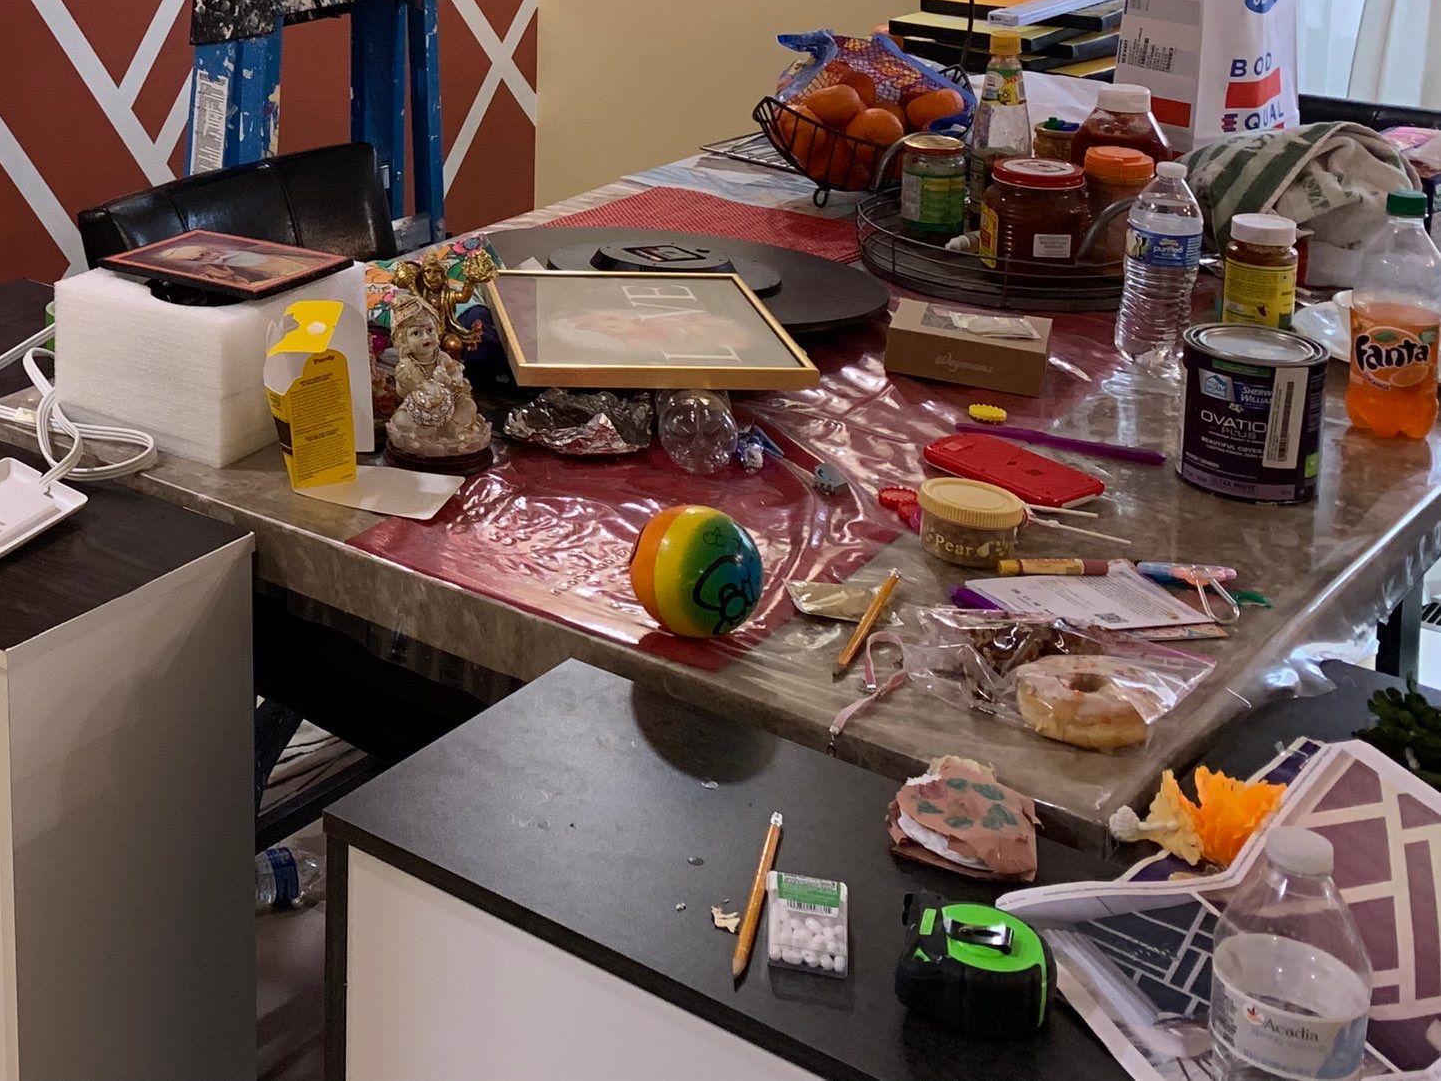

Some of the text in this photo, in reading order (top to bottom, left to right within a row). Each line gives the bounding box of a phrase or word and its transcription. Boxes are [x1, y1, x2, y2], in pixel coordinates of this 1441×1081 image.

[1230, 52, 1272, 77] BOD
[1223, 109, 1284, 132] EQUAL
[936, 533, 974, 557] Pear
[1264, 1018, 1319, 1041] Acadia
